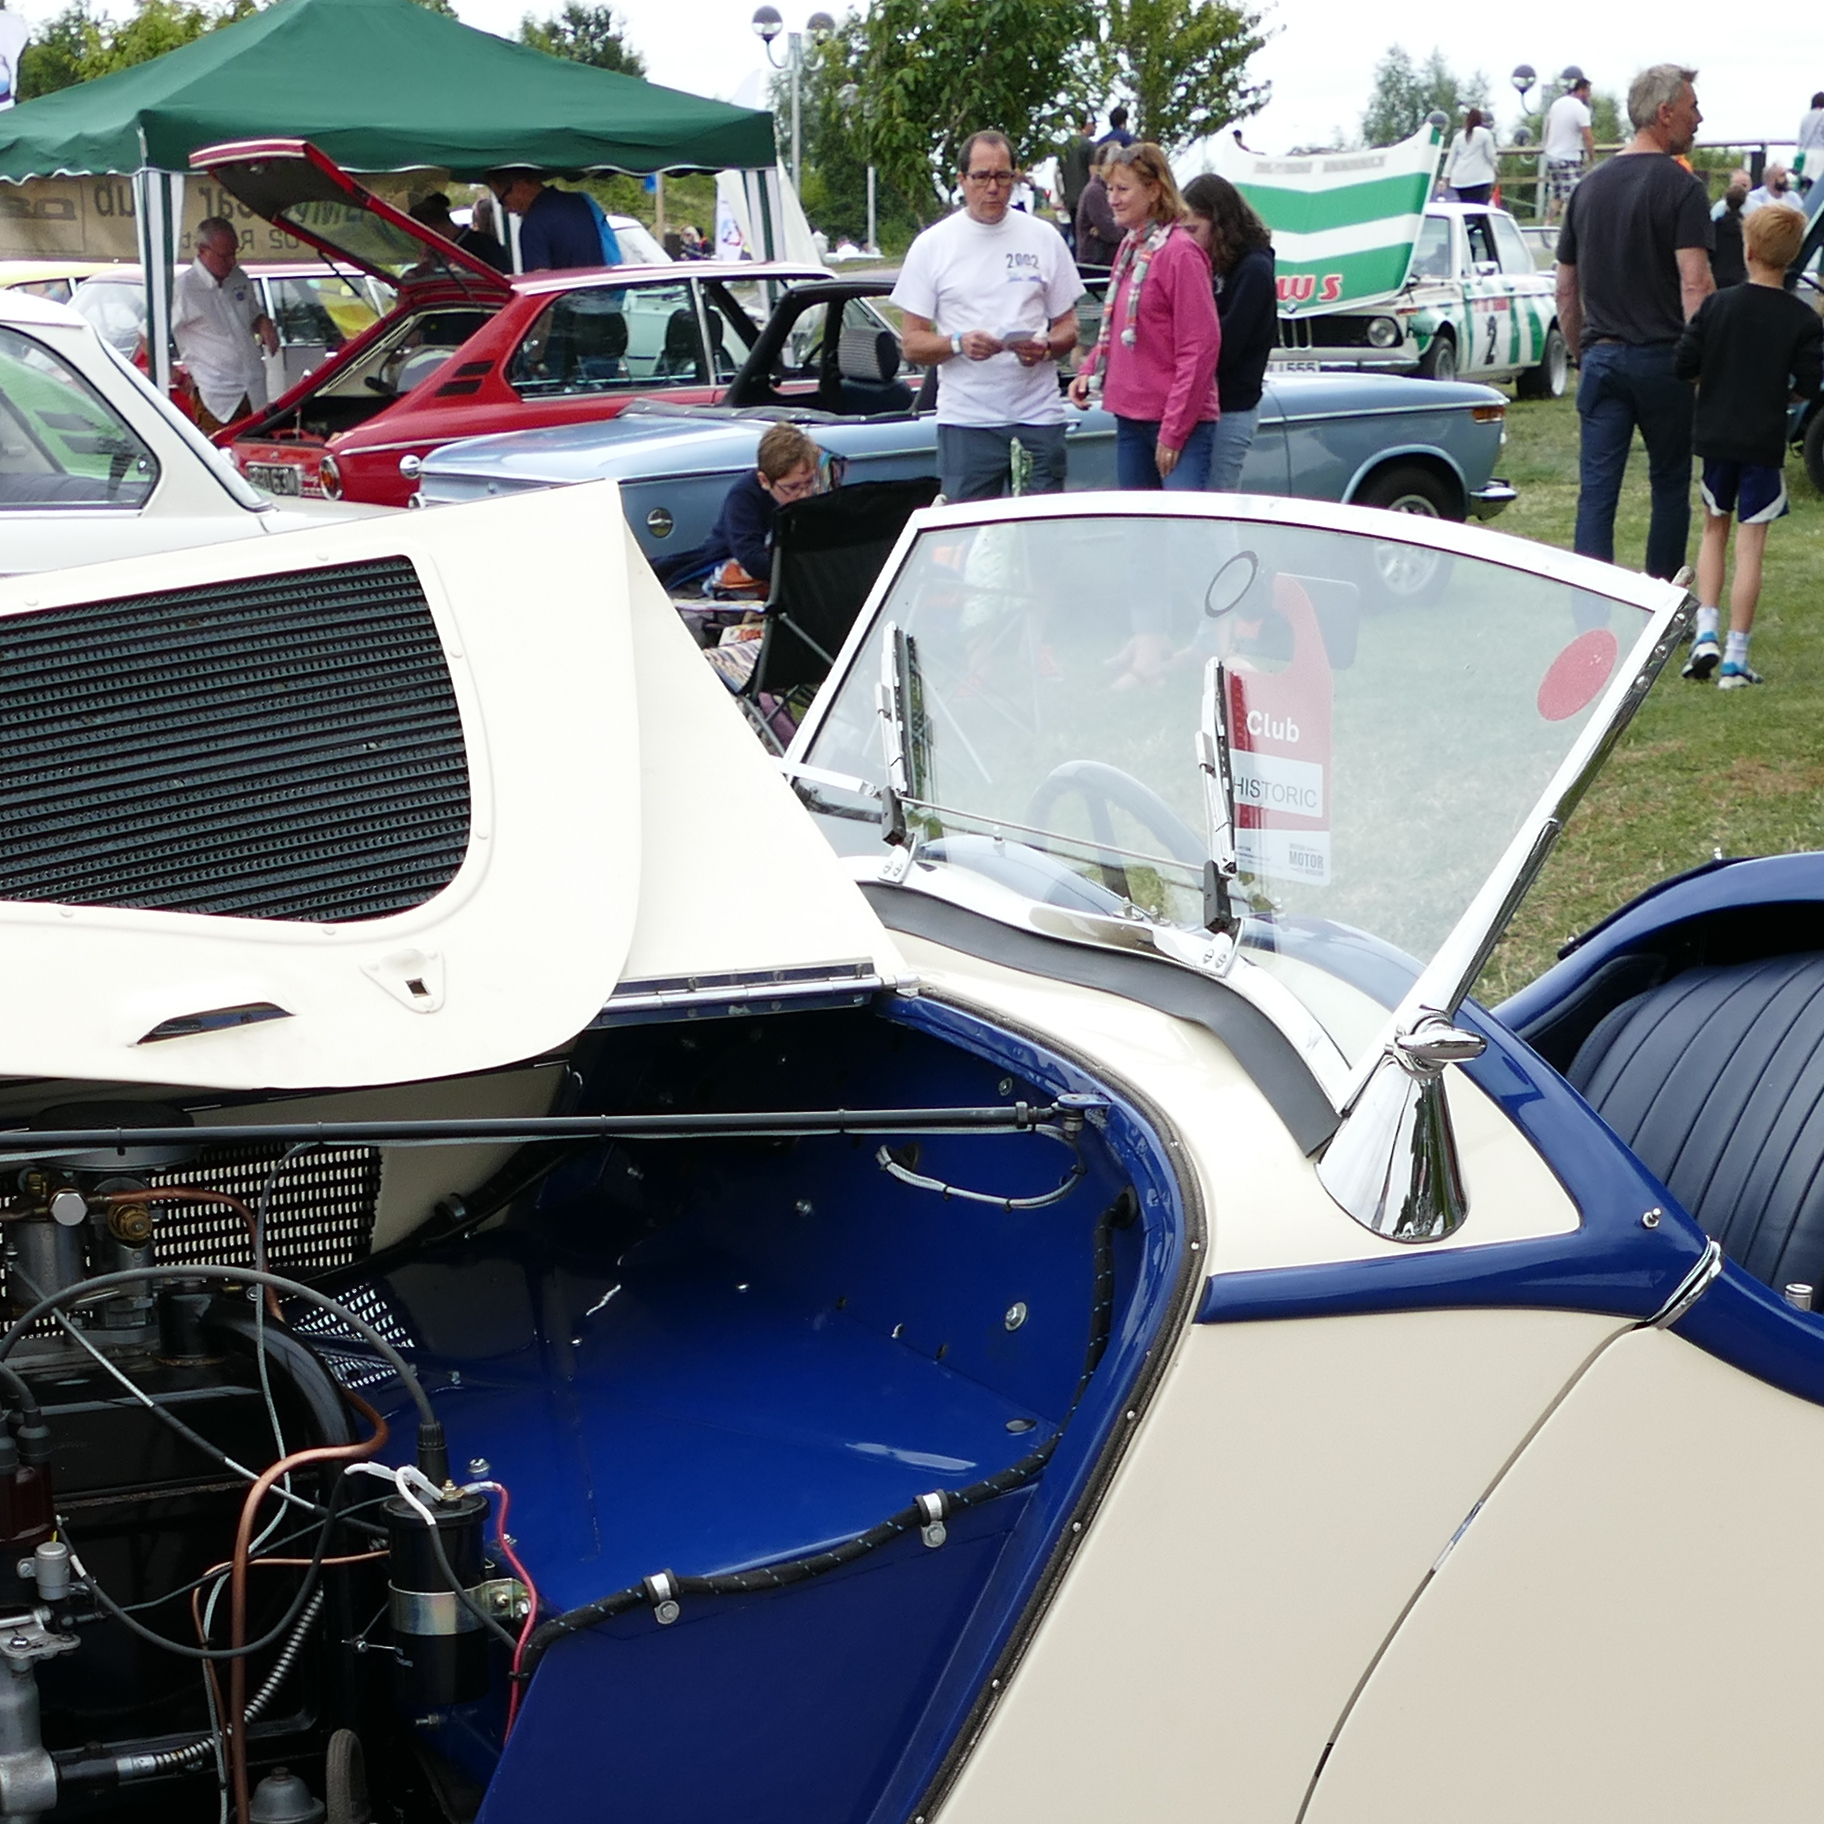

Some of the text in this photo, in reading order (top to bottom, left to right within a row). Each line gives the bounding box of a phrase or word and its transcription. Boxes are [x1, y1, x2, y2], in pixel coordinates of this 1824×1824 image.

[1483, 315, 1498, 365] 2
[1245, 709, 1301, 743] Club
[1233, 776, 1318, 809] HISTORIC
[1288, 850, 1325, 870] MOTOR
